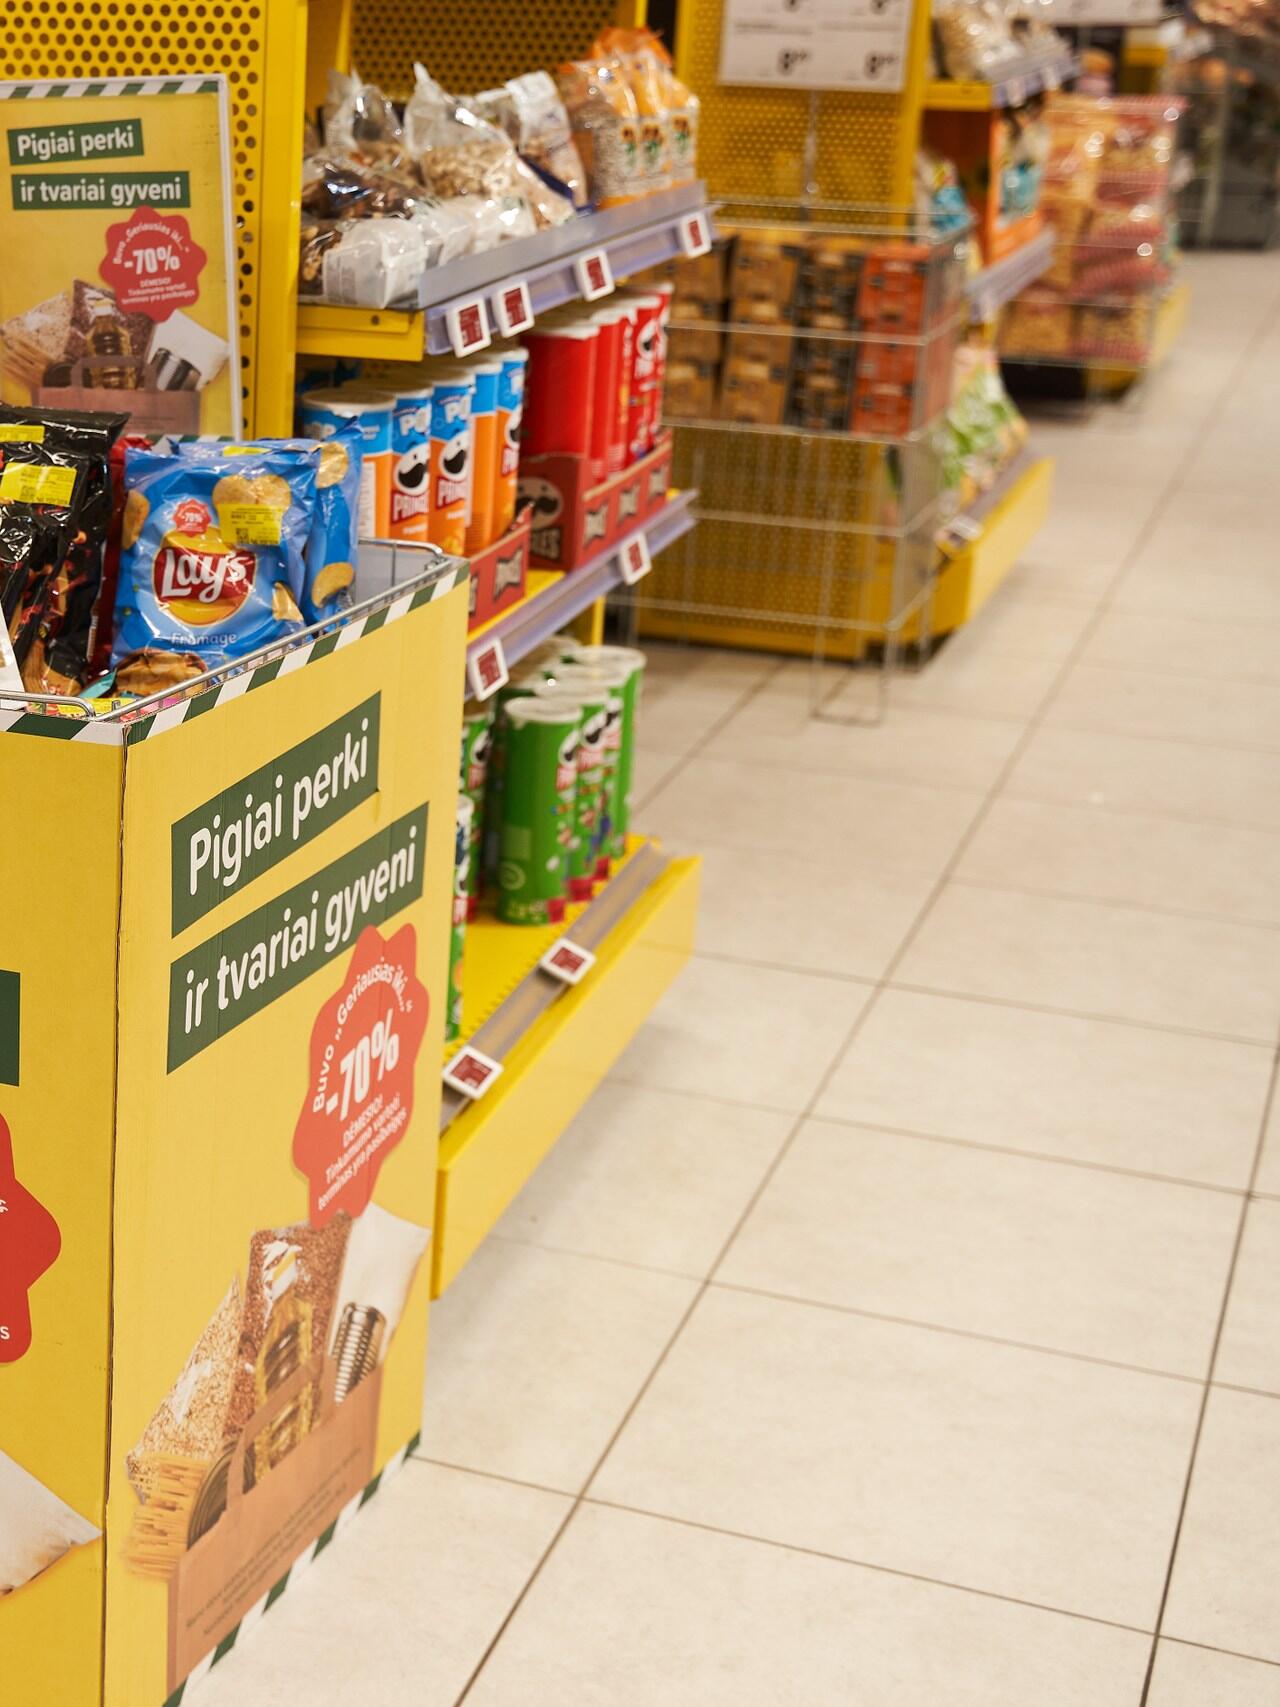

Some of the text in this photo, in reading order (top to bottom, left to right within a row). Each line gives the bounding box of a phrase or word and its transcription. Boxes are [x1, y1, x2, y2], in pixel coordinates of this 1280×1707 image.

[17, 125, 134, 160] Pigiai perki
[20, 177, 181, 206] ir tvariai gyveni
[124, 245, 181, 275] -70%
[161, 548, 251, 604] Lay's
[190, 718, 368, 896] Pigiai perki
[184, 826, 417, 1034] ir tvariai gyveni
[312, 1044, 334, 1113] Buvo
[325, 1008, 400, 1121] -70%
